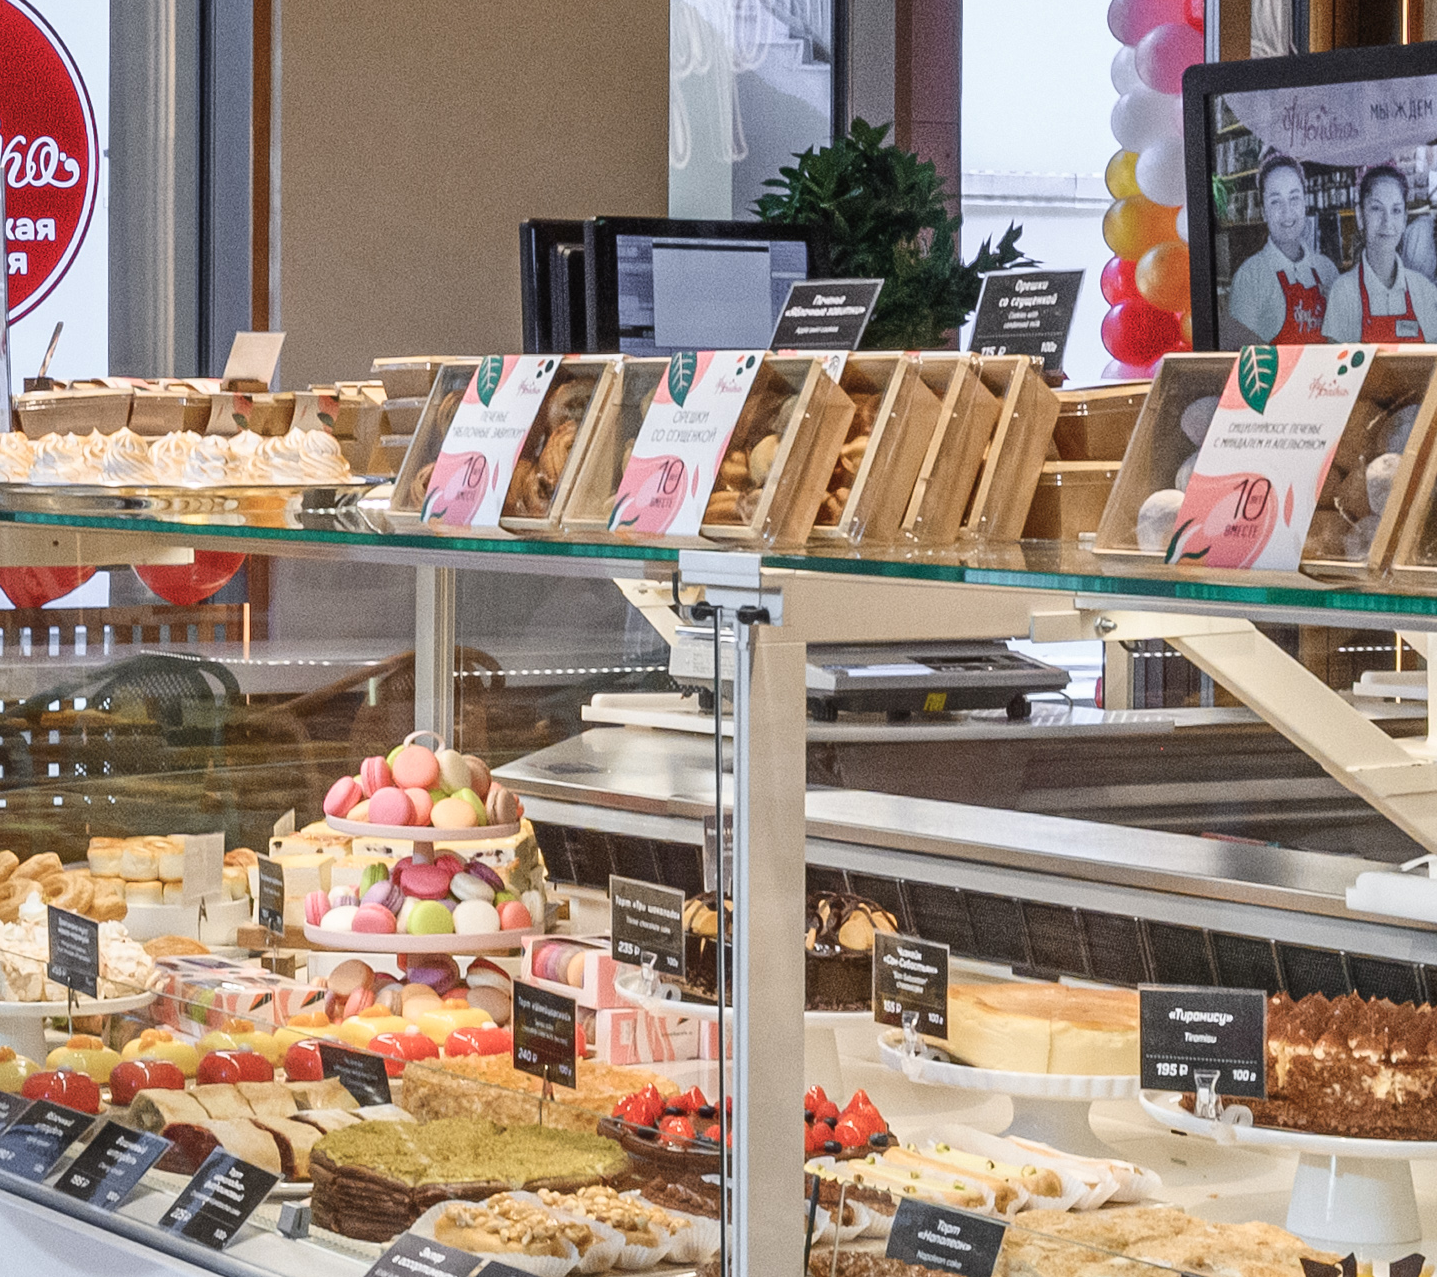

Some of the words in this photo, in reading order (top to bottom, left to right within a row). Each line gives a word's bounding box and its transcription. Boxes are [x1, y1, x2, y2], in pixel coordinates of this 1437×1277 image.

[1370, 104, 1389, 121] МЫ
[1395, 99, 1432, 121] ЖДЕМ
[1014, 279, 1049, 294] Орешки
[998, 297, 1009, 308] со
[461, 454, 487, 489] 10
[655, 456, 684, 495] 10
[1234, 477, 1272, 522] 10
[615, 895, 631, 909] Торт
[617, 940, 634, 956] 235
[1168, 1008, 1233, 1026] «Тирамису»
[1185, 1032, 1217, 1043] Tiramisu
[1156, 1063, 1177, 1076] 195
[1232, 1069, 1249, 1081] 100
[937, 1219, 961, 1236] Торт
